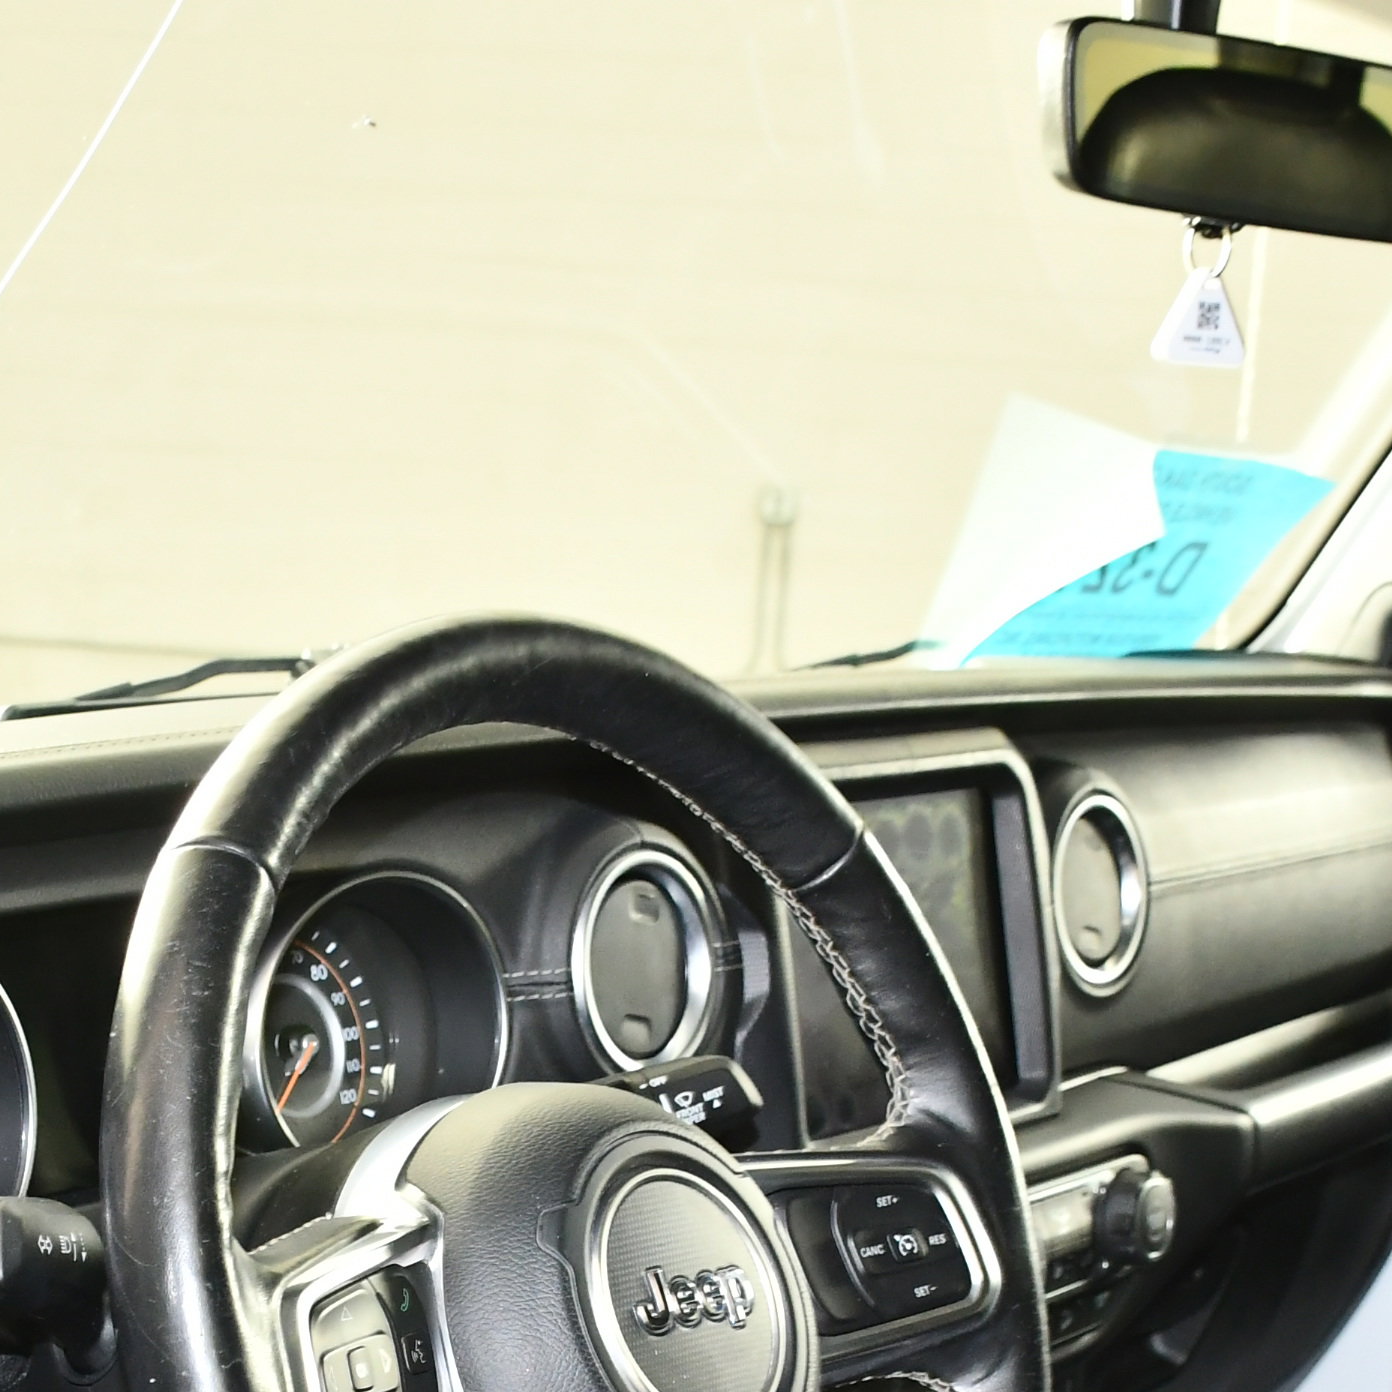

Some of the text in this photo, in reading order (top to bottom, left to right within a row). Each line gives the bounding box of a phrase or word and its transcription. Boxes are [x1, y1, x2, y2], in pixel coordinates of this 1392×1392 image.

[310, 964, 328, 981] 80
[331, 992, 346, 1006] 90
[340, 1090, 357, 1105] 120
[928, 1233, 947, 1246] RES
[860, 1244, 885, 1258] CANC
[633, 1265, 755, 1336] Jeep
